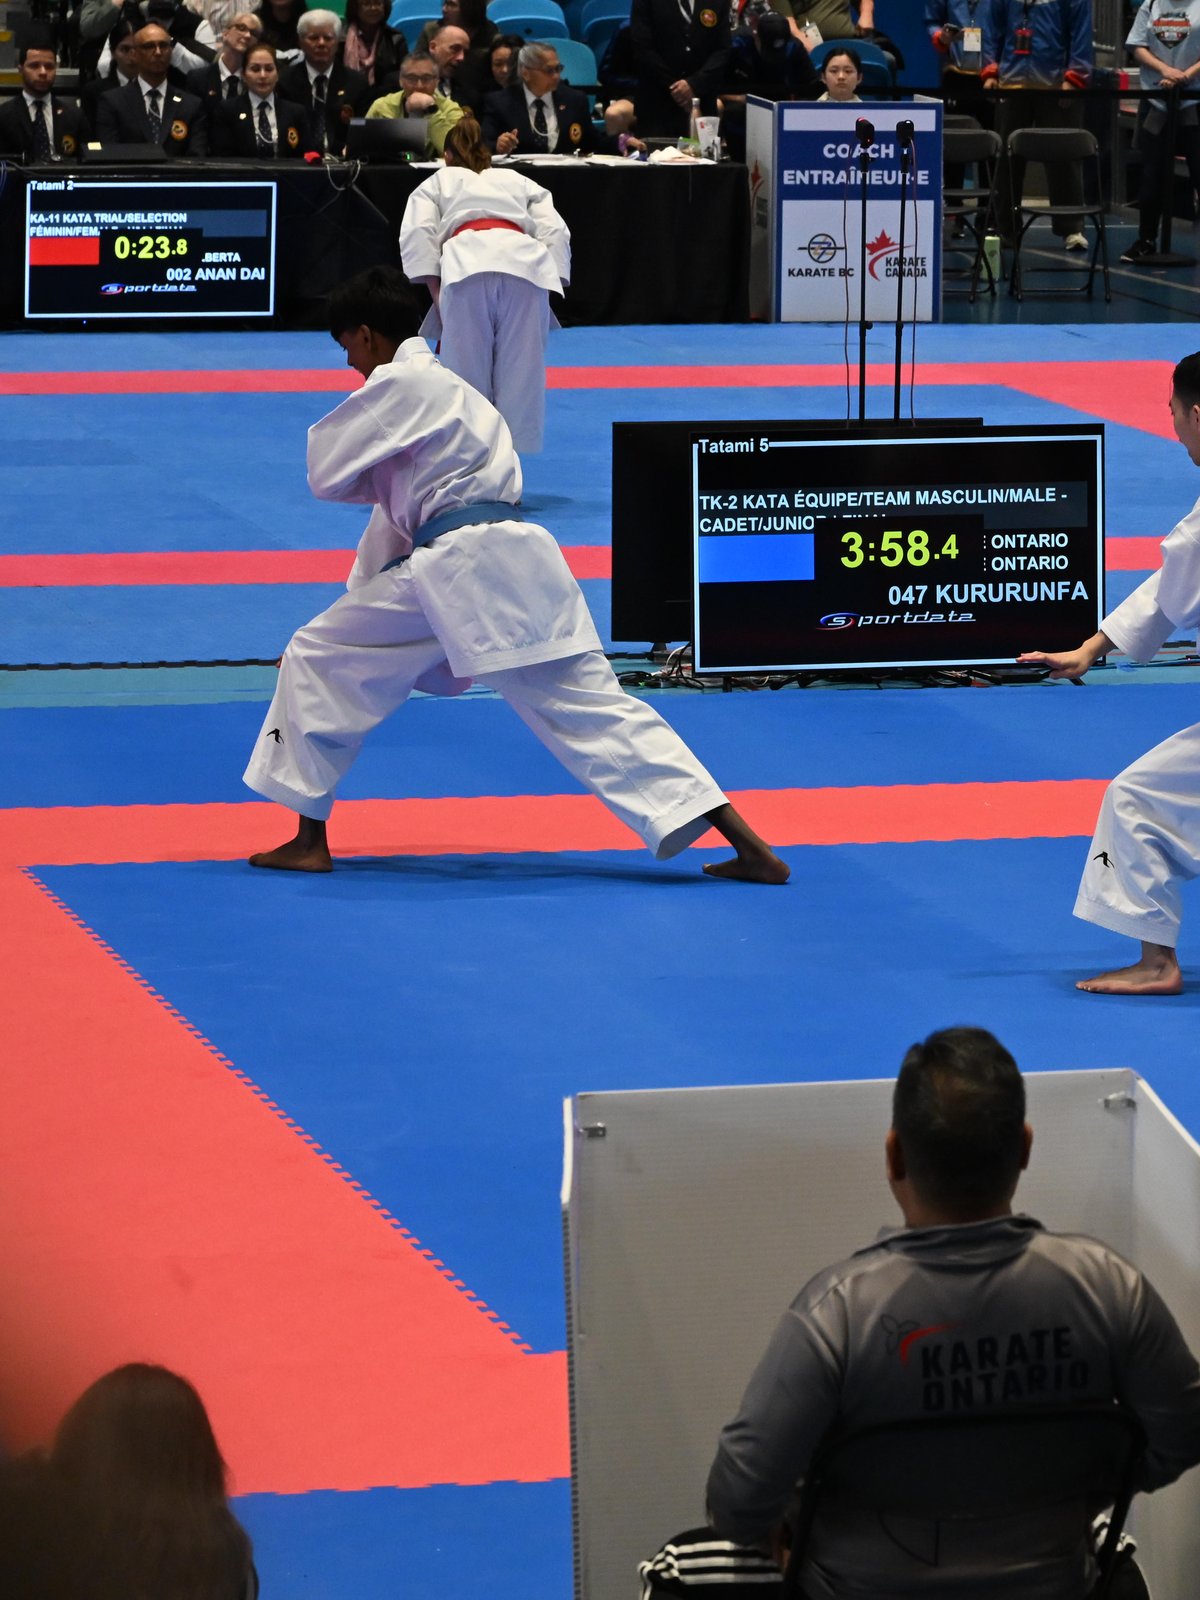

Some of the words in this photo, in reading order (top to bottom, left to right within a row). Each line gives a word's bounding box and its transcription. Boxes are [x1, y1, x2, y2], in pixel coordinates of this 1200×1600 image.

[30, 180, 65, 191] Tatami
[66, 180, 74, 191] 2
[30, 213, 60, 224] KA-11
[62, 212, 93, 224] KATA
[94, 212, 188, 224] TRIAL/SELECTION
[114, 235, 188, 259] 0:23.8
[885, 256, 927, 267] KARATE
[166, 268, 192, 281] 002
[195, 267, 237, 281] ANAN
[240, 267, 266, 280] DAI
[788, 268, 836, 277] KARATE
[838, 267, 855, 277] BC
[885, 267, 928, 278] CANADA
[699, 438, 754, 453] Tatami
[759, 437, 769, 452] 5
[700, 495, 738, 510] TK-2
[743, 493, 790, 509] KATA
[794, 489, 911, 508] ÉQUIPE/TEAM
[915, 487, 1057, 505] MASCULIN/MALE
[700, 515, 826, 533] CADET/JUNIO
[840, 529, 960, 569] 3:58.4
[991, 532, 1069, 550] ONTARIO
[991, 555, 1069, 572] ONTARIO
[888, 584, 928, 606] 047
[935, 580, 1089, 604] KURURUNFA
[921, 1326, 1073, 1379] KARATE
[922, 1358, 1090, 1411] ONTARIO
